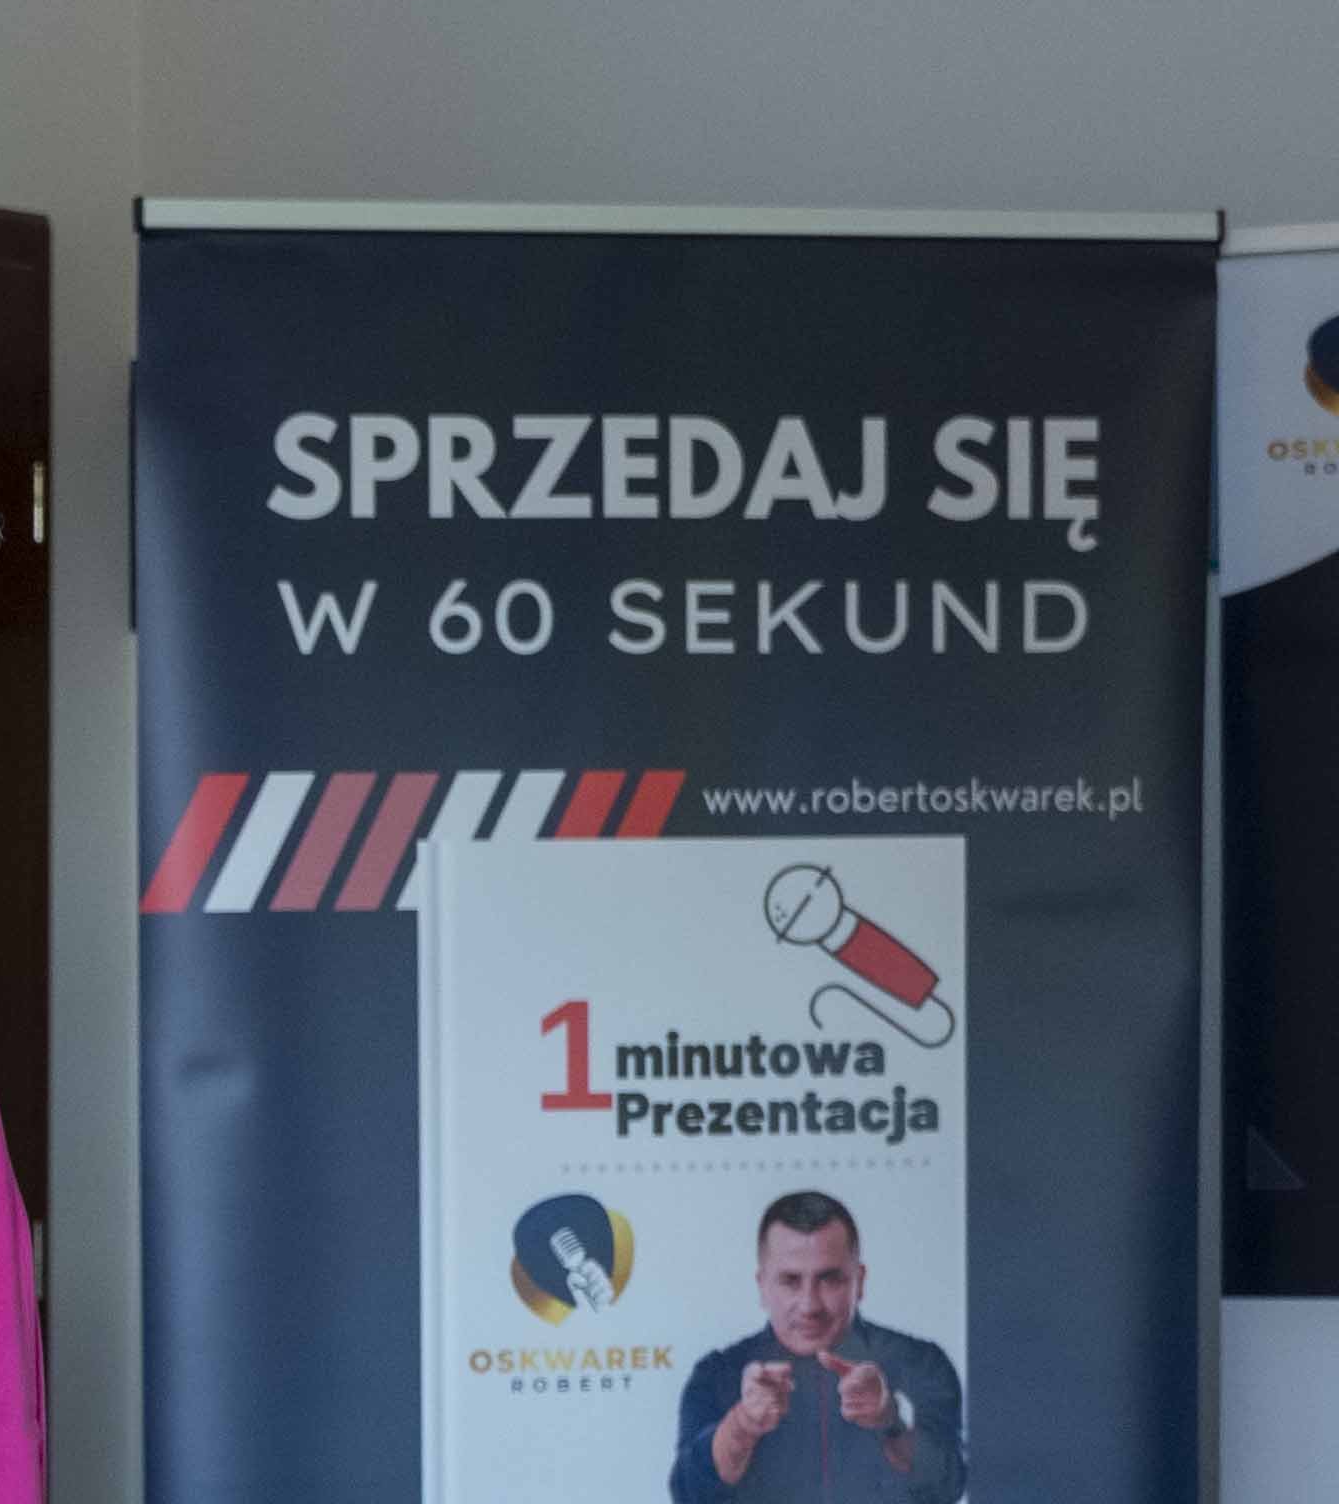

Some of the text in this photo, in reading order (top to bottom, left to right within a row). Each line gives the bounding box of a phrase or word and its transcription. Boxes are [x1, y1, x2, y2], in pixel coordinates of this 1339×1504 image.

[267, 412, 1100, 552] SPRZEDAJ SIĘ
[277, 579, 1089, 656] W 60 SEKUND
[702, 777, 1143, 819] www.robertoskwarek.pl
[540, 999, 885, 1112] 1 minutowa
[617, 1085, 940, 1145] Prezentacja
[469, 1346, 673, 1375] OSKWAREK
[510, 1376, 632, 1393] ROBERT
